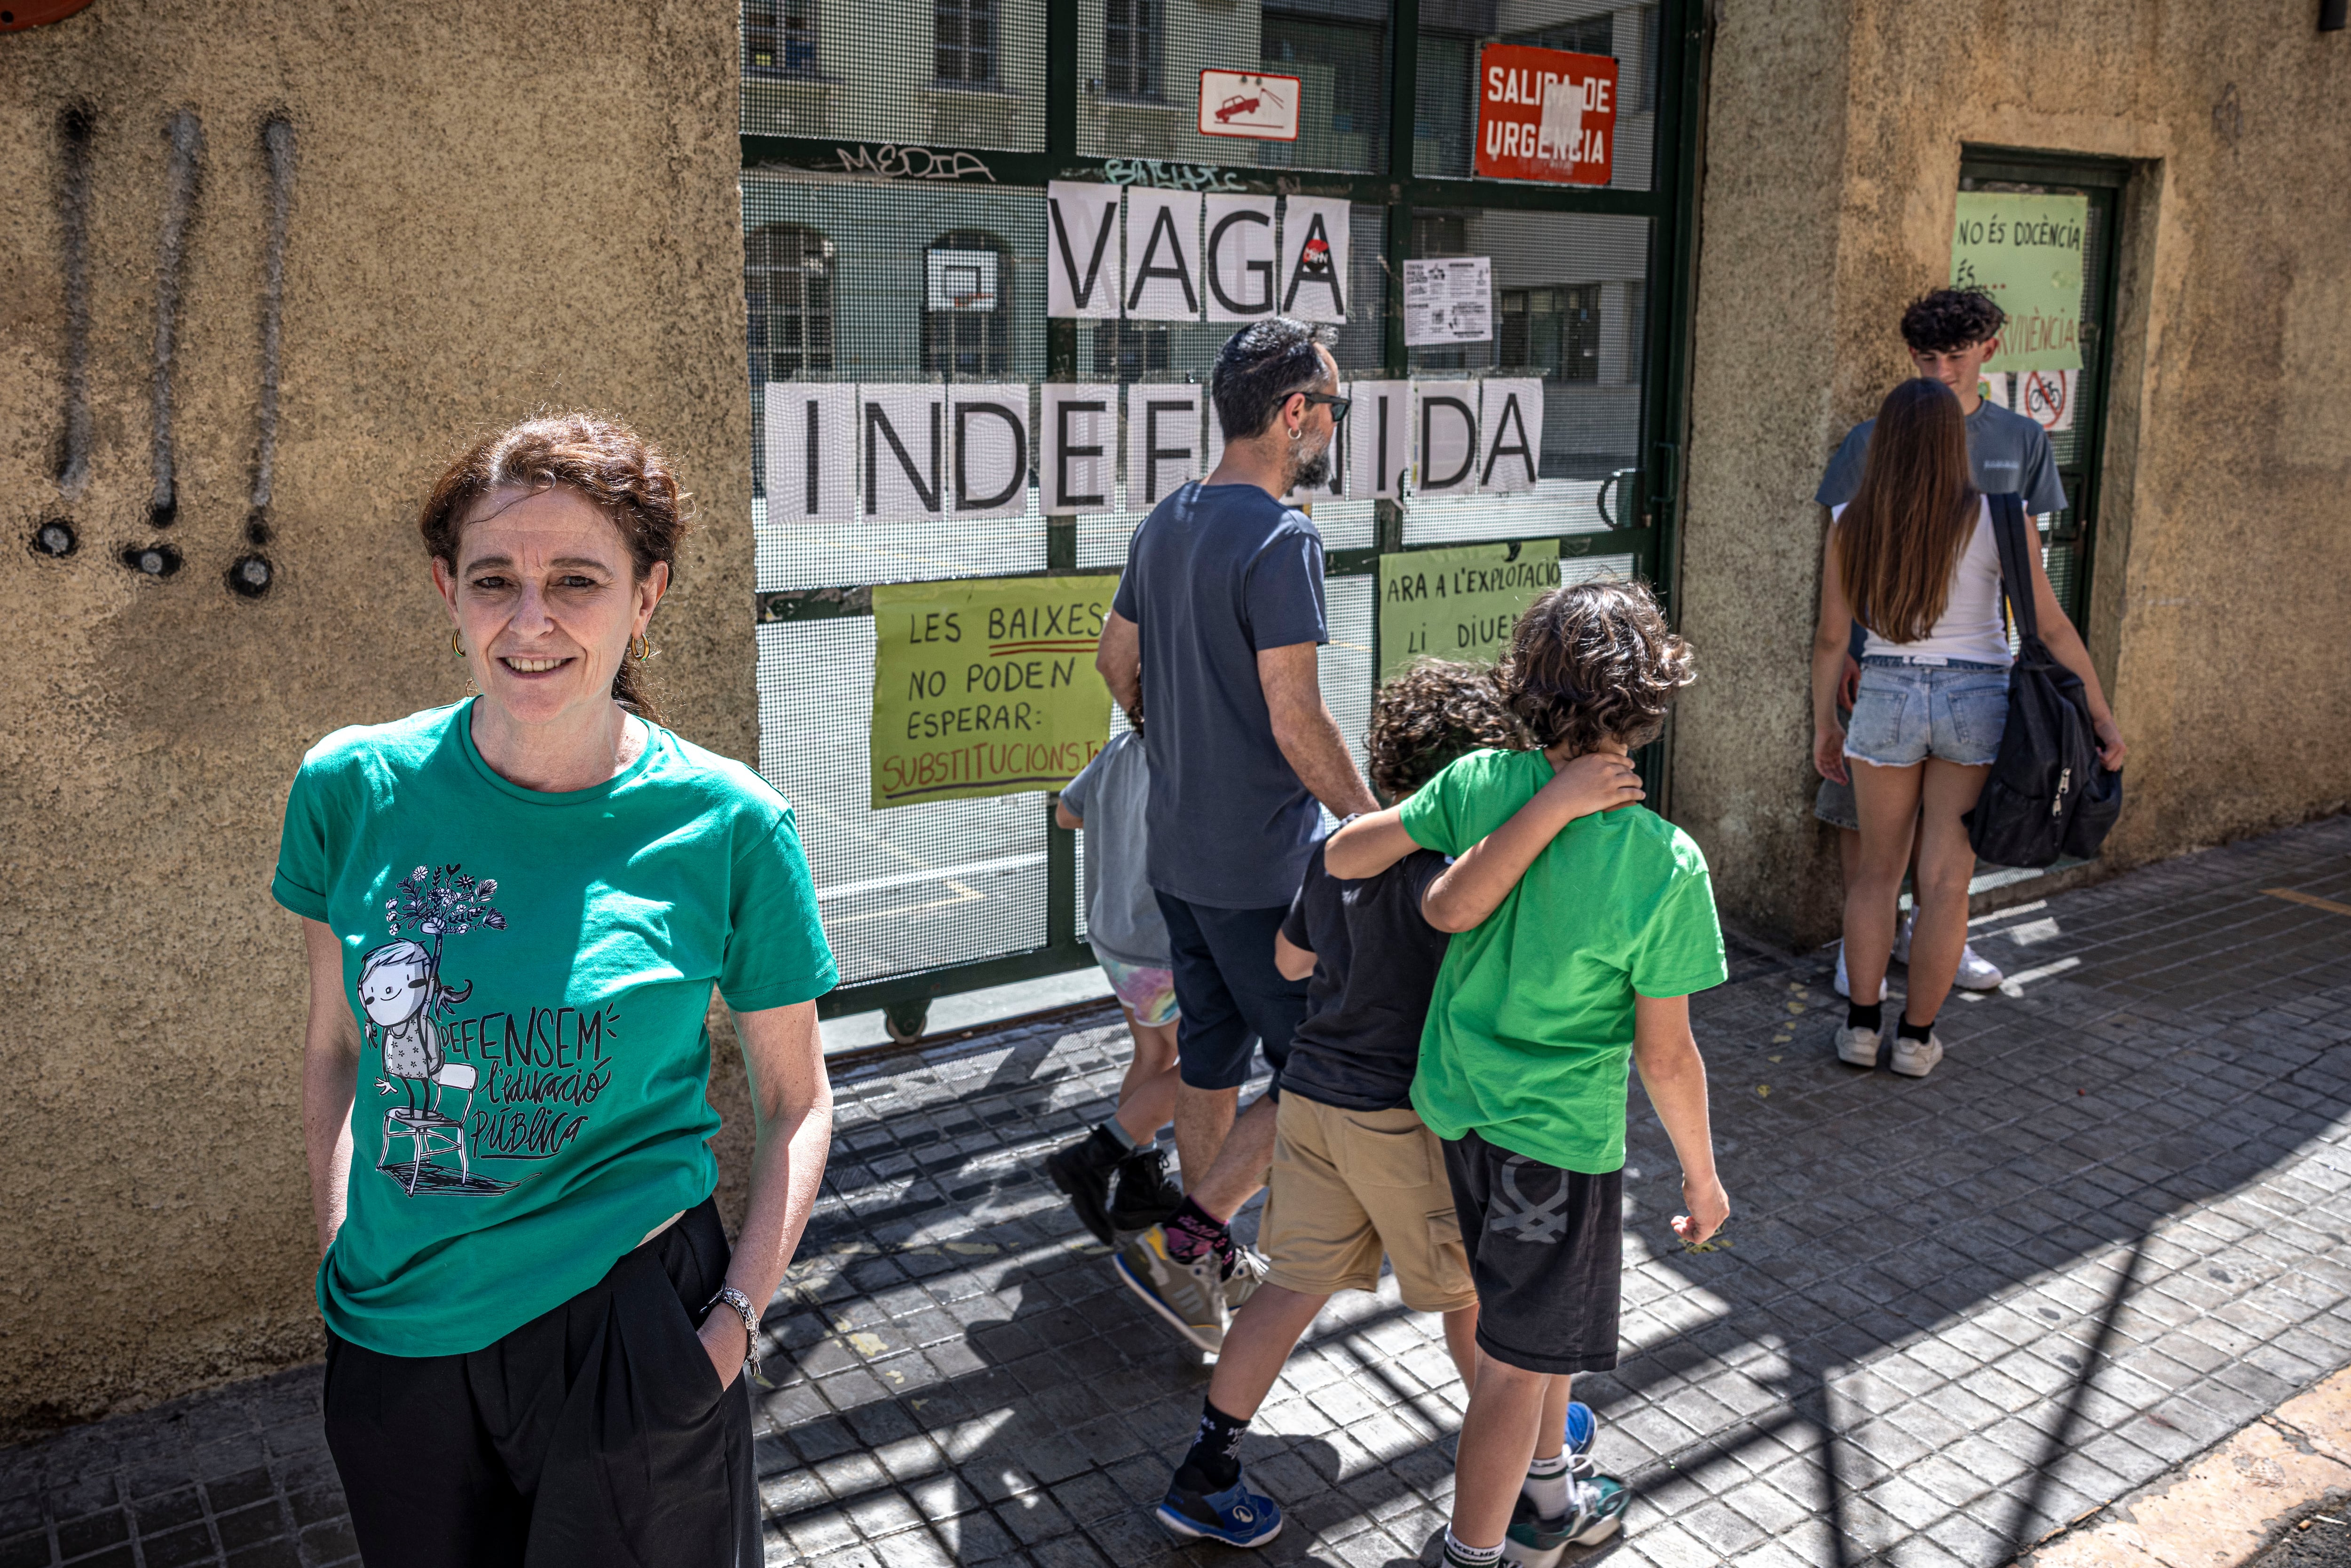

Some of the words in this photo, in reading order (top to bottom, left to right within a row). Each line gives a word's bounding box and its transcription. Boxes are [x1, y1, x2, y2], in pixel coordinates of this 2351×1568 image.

[1582, 76, 1612, 113] DE
[1485, 119, 1605, 165] URGENCIA
[1957, 219, 1984, 246] NO
[1988, 213, 2007, 244] ÉS
[2014, 213, 2081, 251] DOCÈNCIA
[1049, 198, 1344, 315] VAGA
[806, 393, 1537, 515] INDEFIDA
[1387, 572, 1428, 602] ARA
[1436, 574, 1446, 598] A
[909, 612, 962, 644] LES
[988, 602, 1104, 639] BAIXES
[908, 670, 946, 701] NO
[966, 657, 1076, 693] PODEN
[907, 701, 1042, 740] ESPERAR:
[882, 741, 1080, 792] SUBSTITUCIONS
[441, 1006, 602, 1069] DEFENSEM
[480, 1056, 612, 1108] l'educació
[1454, 1542, 1496, 1557] KELME
